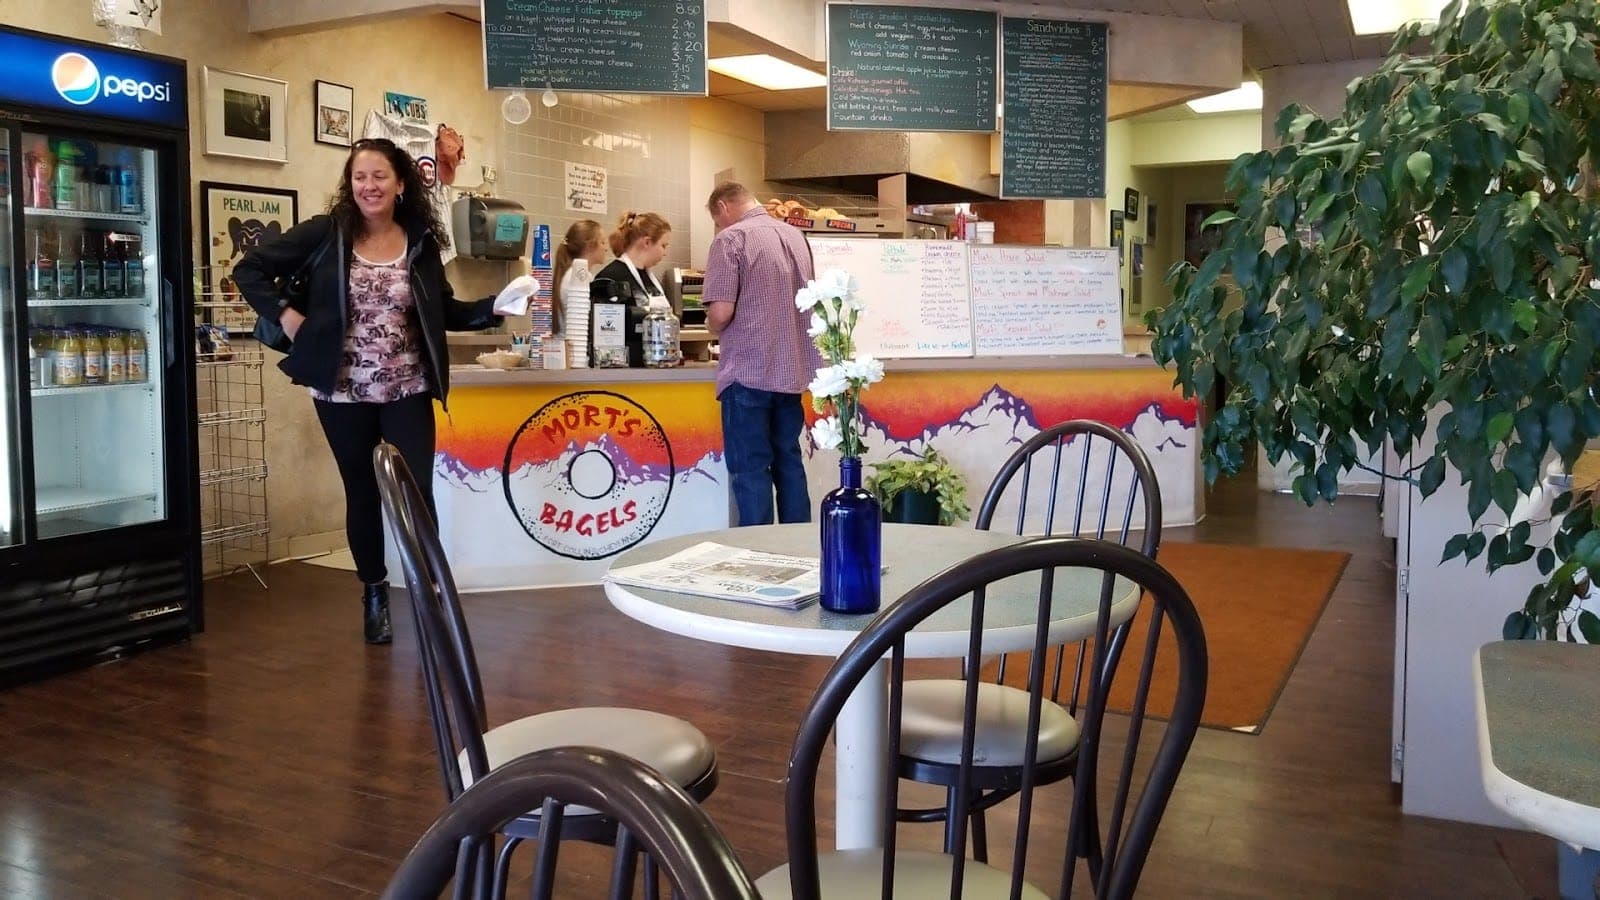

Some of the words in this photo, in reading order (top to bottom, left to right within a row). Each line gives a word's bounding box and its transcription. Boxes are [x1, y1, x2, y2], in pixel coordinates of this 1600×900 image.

[103, 75, 170, 103] pepsi
[405, 102, 426, 119] CUBS
[223, 197, 257, 213] PEARL
[259, 201, 280, 215] JAM
[541, 405, 641, 444] MORT'S
[540, 499, 637, 537] BAGELS
